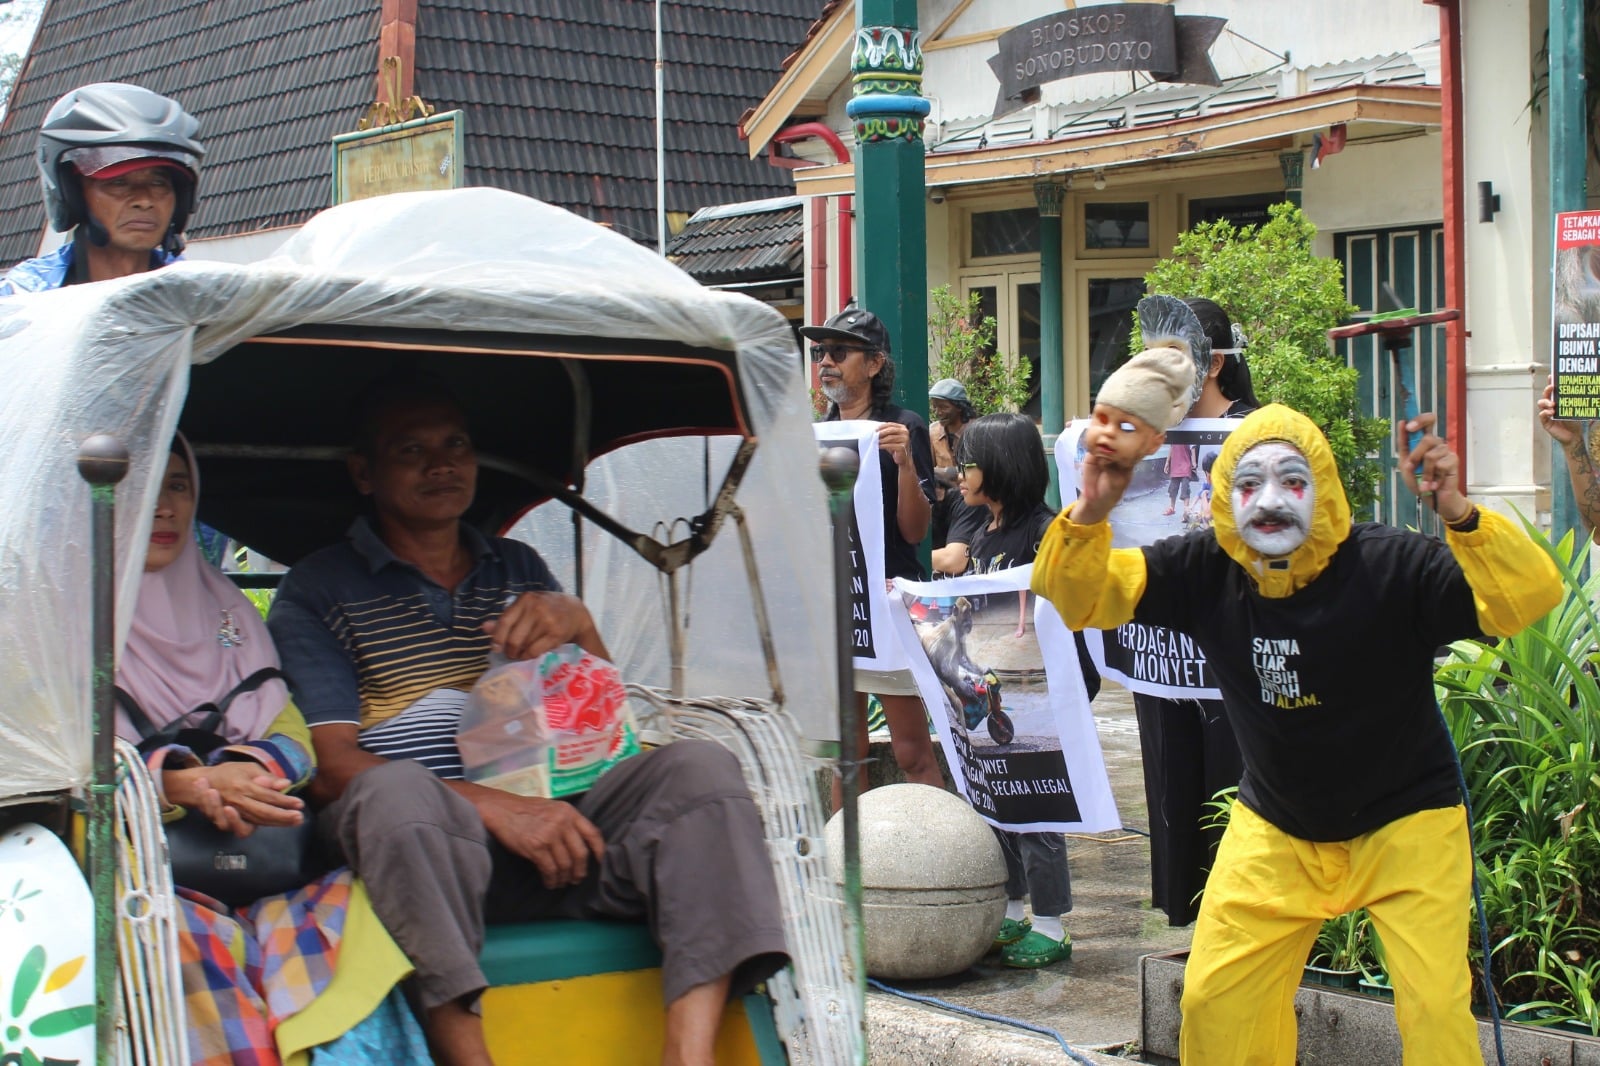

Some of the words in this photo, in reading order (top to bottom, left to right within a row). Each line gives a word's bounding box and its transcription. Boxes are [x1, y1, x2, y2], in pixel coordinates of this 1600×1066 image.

[1031, 13, 1127, 48] BIOSKOP
[1015, 41, 1153, 80] SONOBUDOYO
[1562, 229, 1595, 241] SEBAGAI
[1559, 340, 1595, 356] IBUNYA
[1558, 357, 1597, 373] DENGAN
[1558, 385, 1586, 395] SEBAGAI
[1558, 397, 1590, 407] MEMBUAT
[1558, 407, 1573, 417] LIAR
[1574, 407, 1597, 418] MAKIN
[1252, 637, 1301, 656] SATWA
[1133, 651, 1207, 688] MONYET
[1252, 652, 1287, 672] LIAR
[1254, 667, 1299, 684] LEBIH
[1261, 688, 1276, 706] DI
[991, 780, 1033, 796] SECARA
[1032, 778, 1071, 795] ILEGAL
